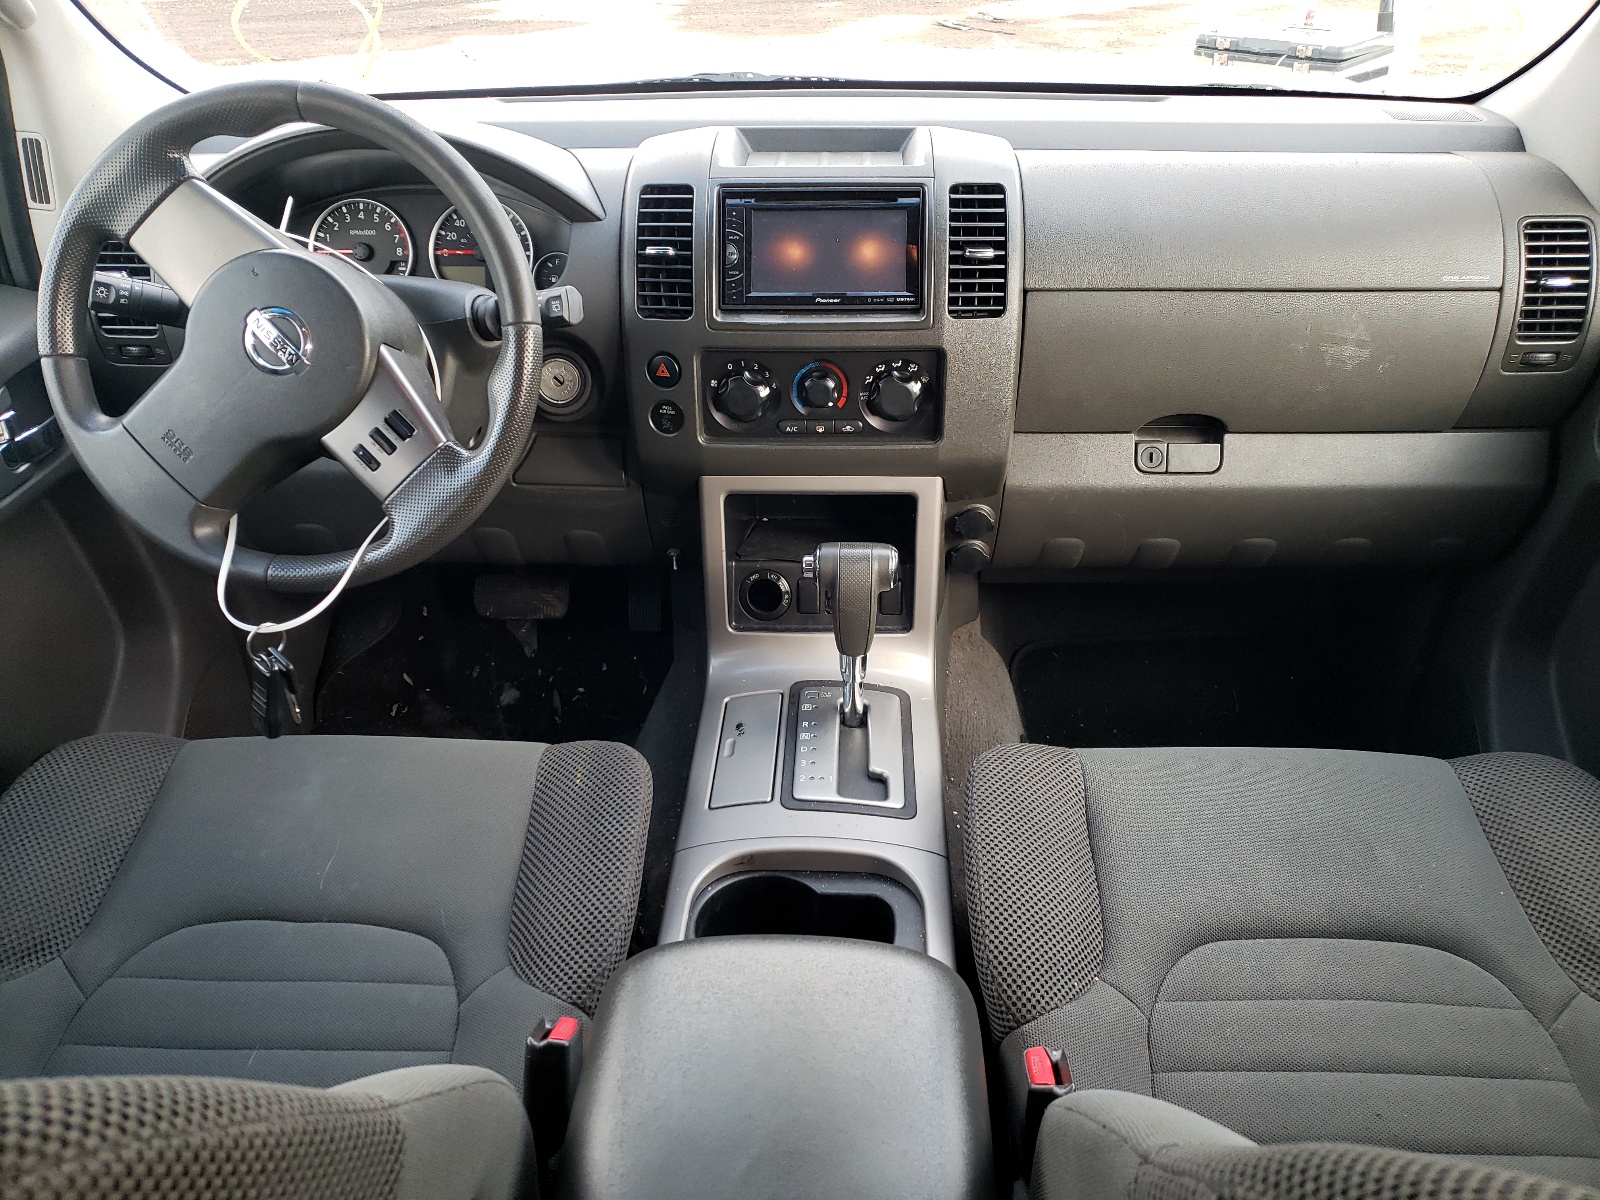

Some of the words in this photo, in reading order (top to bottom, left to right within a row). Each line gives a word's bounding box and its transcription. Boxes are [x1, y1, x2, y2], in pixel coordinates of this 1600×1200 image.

[345, 213, 351, 222] 3
[358, 211, 364, 219] 4
[373, 213, 379, 222] 5
[333, 222, 339, 231] 2
[385, 222, 391, 231] 6
[454, 219, 465, 227] 40
[393, 234, 399, 243] 7
[446, 231, 457, 240] 20
[396, 247, 403, 256] 8
[252, 317, 297, 366] NISSAN
